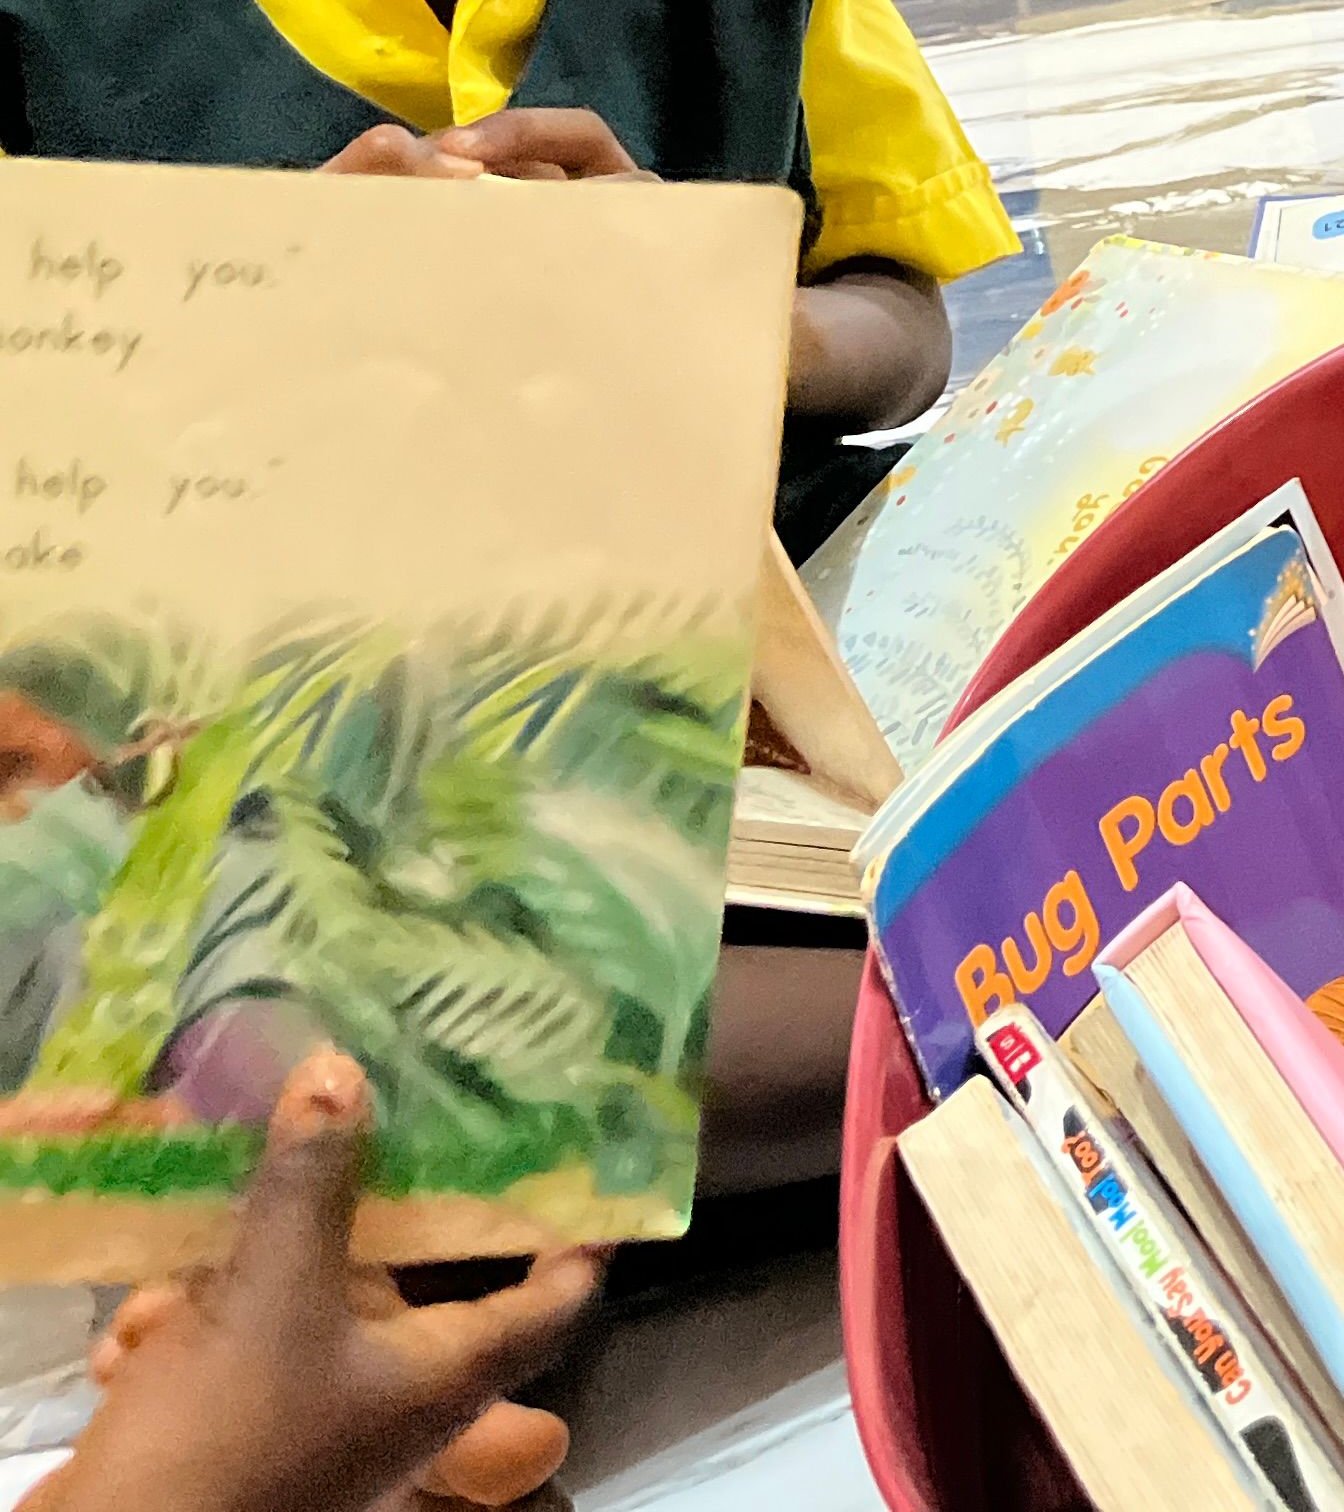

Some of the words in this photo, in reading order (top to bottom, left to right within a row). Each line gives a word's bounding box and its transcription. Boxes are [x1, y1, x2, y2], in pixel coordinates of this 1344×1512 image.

[29, 236, 125, 300] help
[0, 312, 143, 374] onkey
[13, 456, 109, 517] help
[953, 869, 1100, 1028] Bug
[1099, 693, 1306, 892] Parts
[1214, 1349, 1253, 1406] Can
